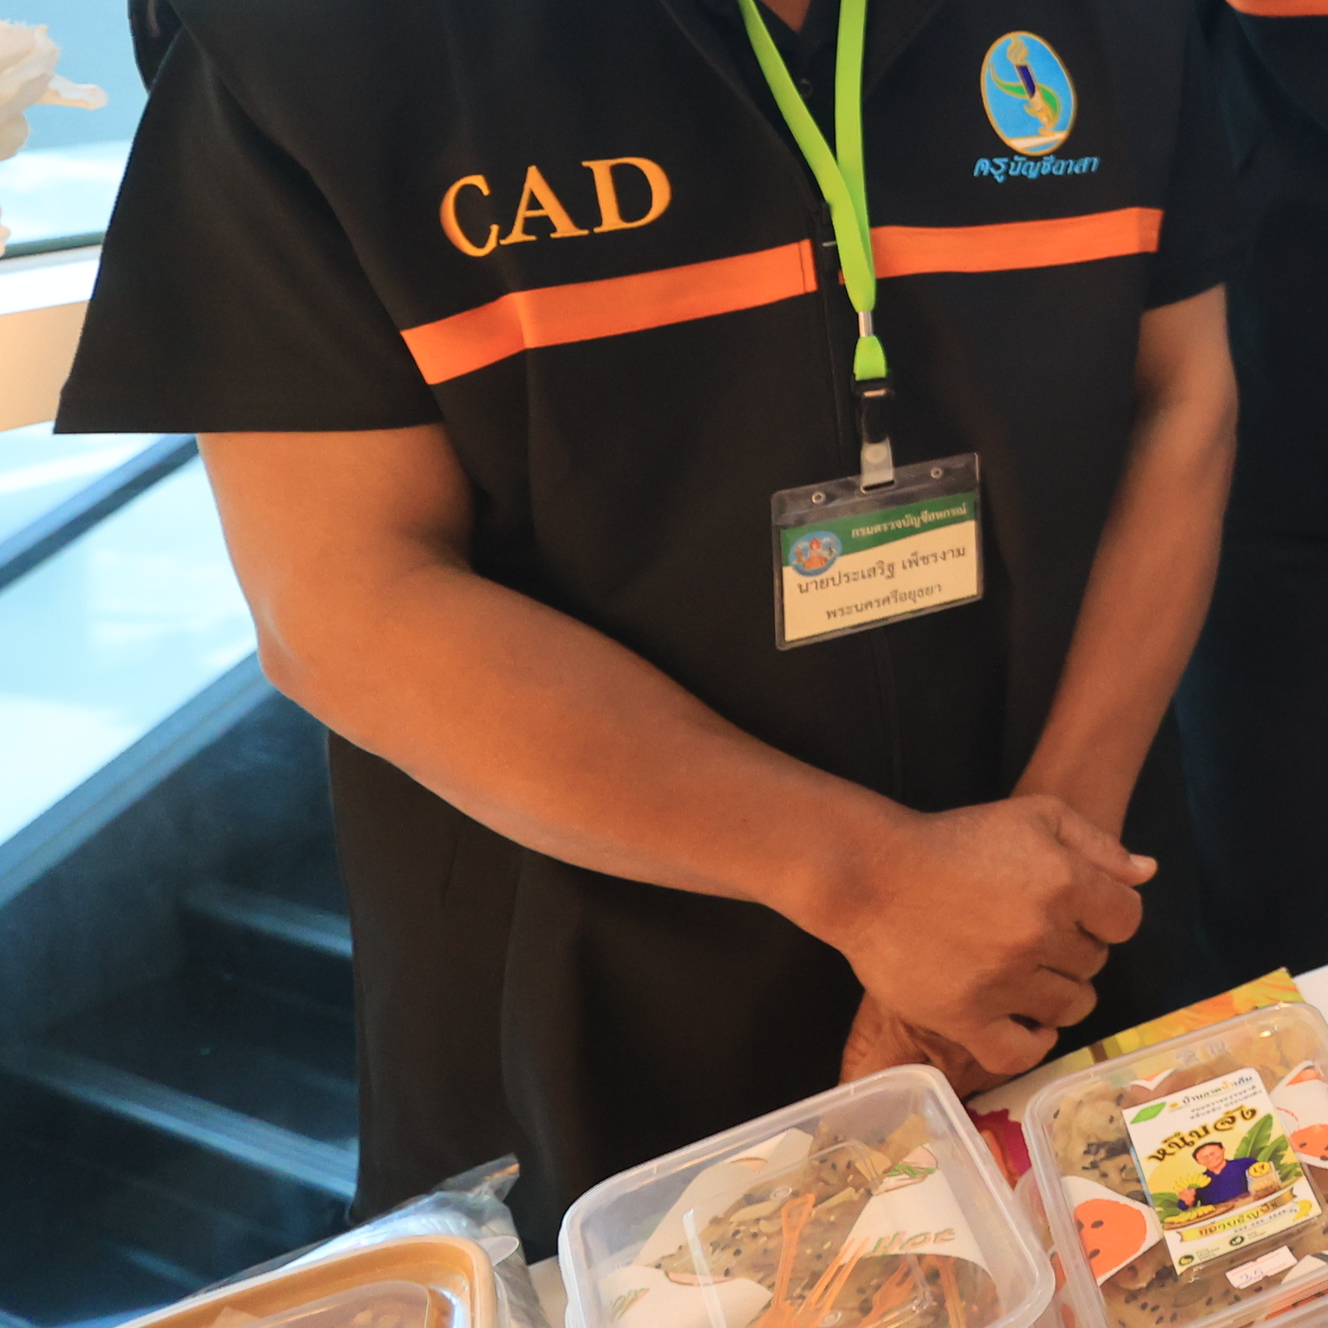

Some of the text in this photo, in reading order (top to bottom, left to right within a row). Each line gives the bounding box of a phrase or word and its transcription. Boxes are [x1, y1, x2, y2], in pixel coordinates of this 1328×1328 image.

[973, 155, 1099, 183] ครูบัญชีอาสา
[440, 157, 672, 257] CAD
[851, 502, 967, 538] กรมตรวจบัญชีสหกรณ์
[797, 560, 895, 594] นายประเสริฐ
[826, 583, 942, 620] พระนครศรีอยุธยา
